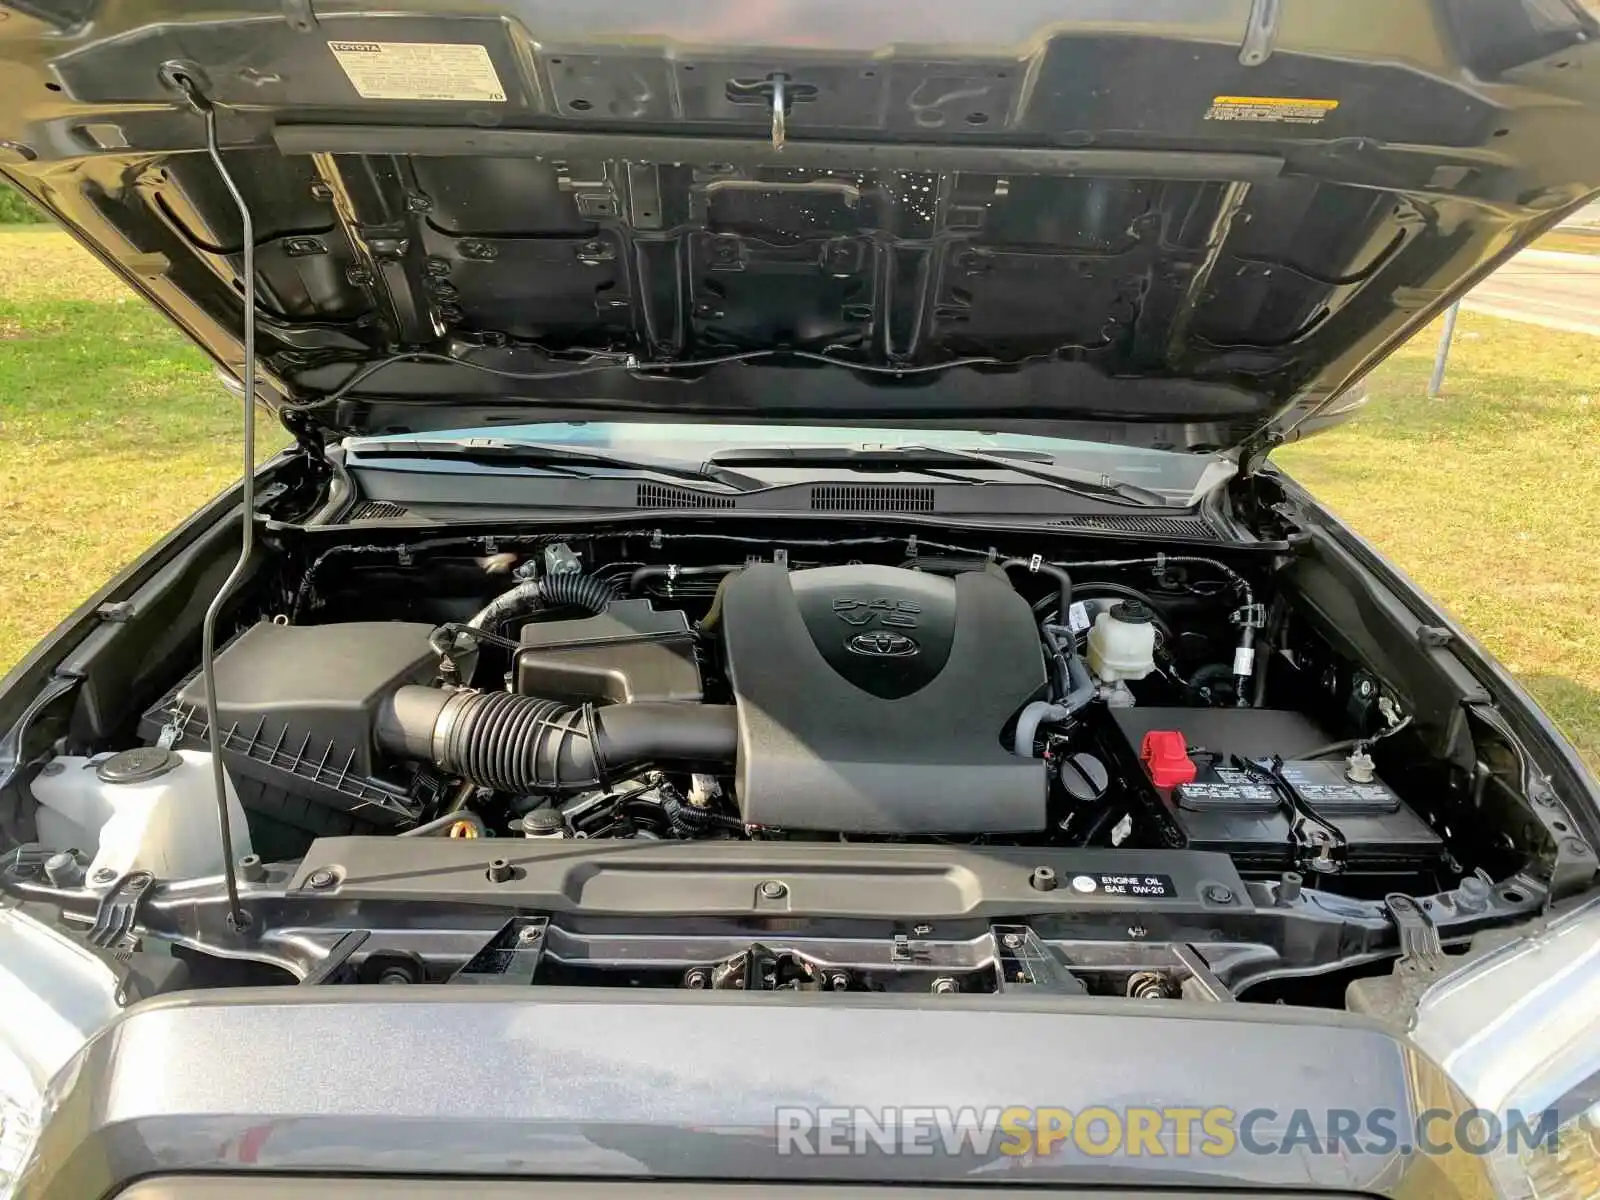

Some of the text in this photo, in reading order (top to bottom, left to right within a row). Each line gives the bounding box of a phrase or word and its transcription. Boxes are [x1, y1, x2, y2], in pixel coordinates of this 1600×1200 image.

[836, 610, 919, 629] V6
[1101, 876, 1163, 886] ENGINE OIL
[1104, 885, 1165, 895] SAE 0W-20
